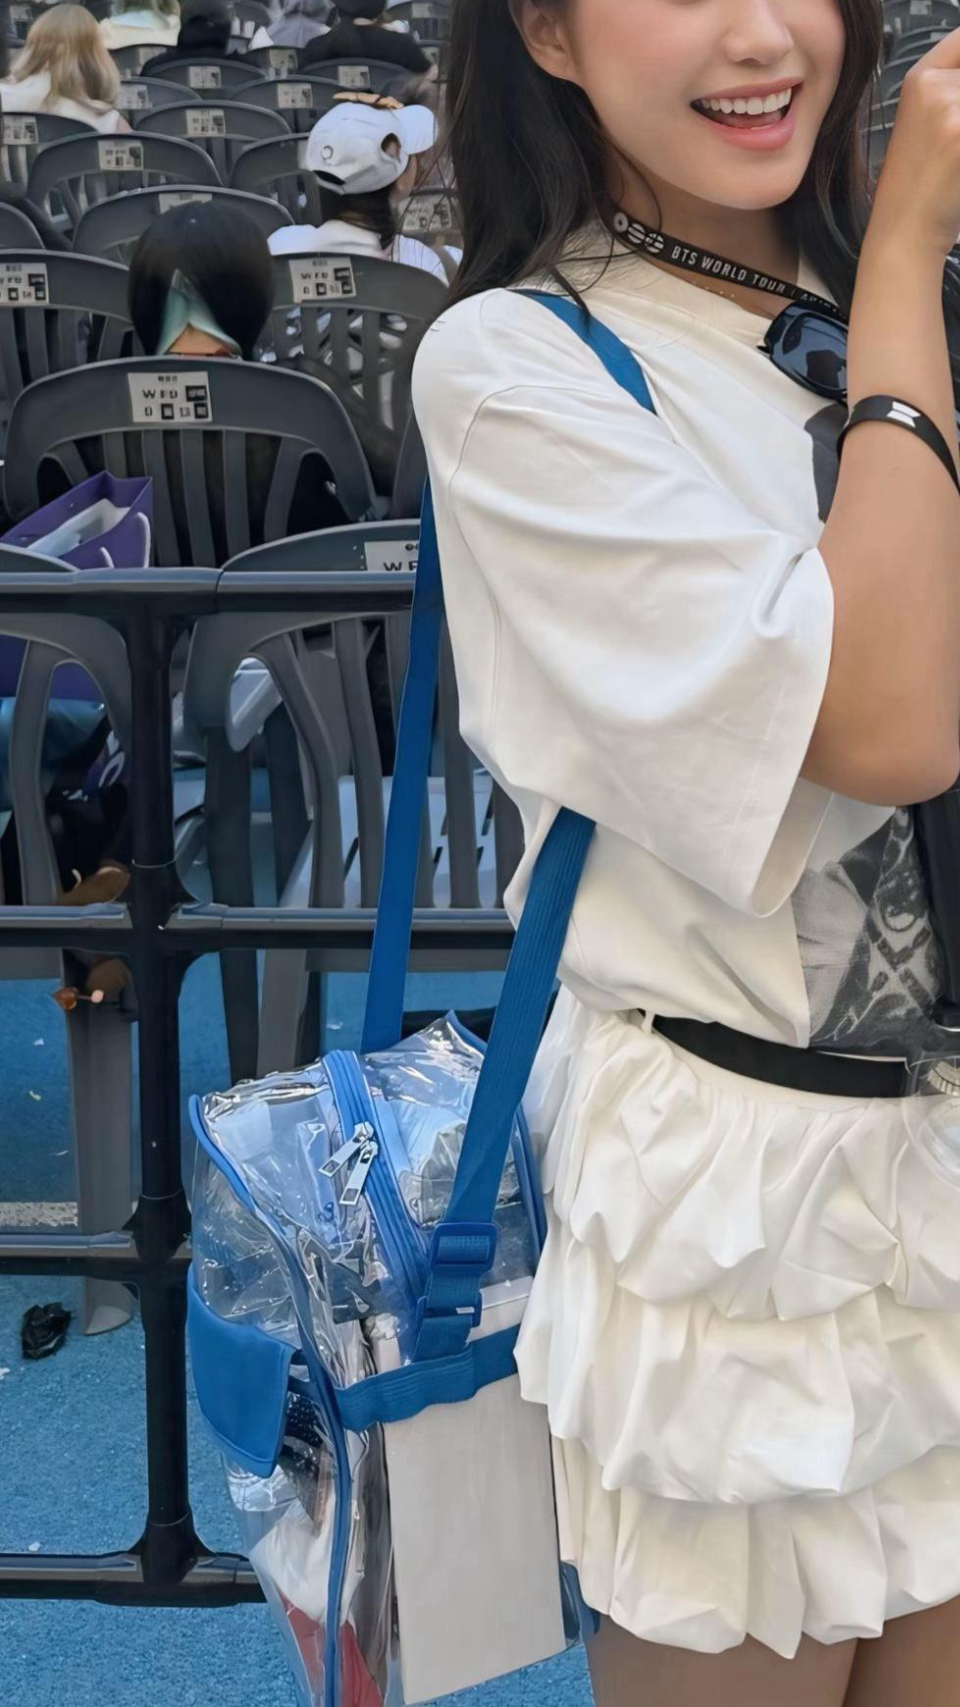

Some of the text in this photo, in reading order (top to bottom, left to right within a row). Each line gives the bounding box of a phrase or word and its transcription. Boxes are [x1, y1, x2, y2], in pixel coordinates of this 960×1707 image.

[671, 245, 787, 294] BTS WORLD TOUR
